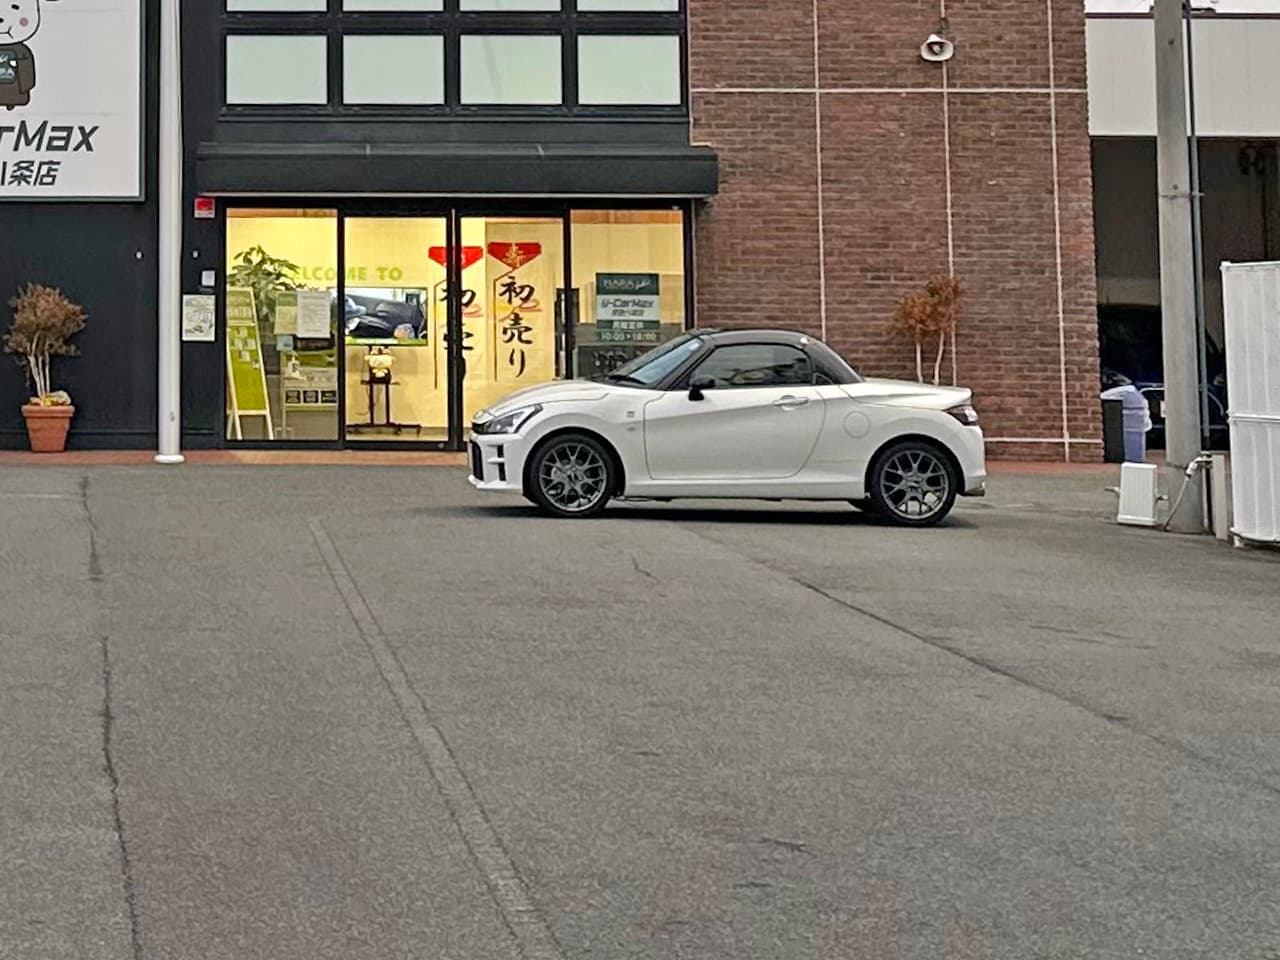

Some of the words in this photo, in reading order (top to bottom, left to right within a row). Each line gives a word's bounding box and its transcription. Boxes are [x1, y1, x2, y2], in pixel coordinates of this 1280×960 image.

[376, 266, 403, 281] TO
[499, 275, 535, 378] 初売り
